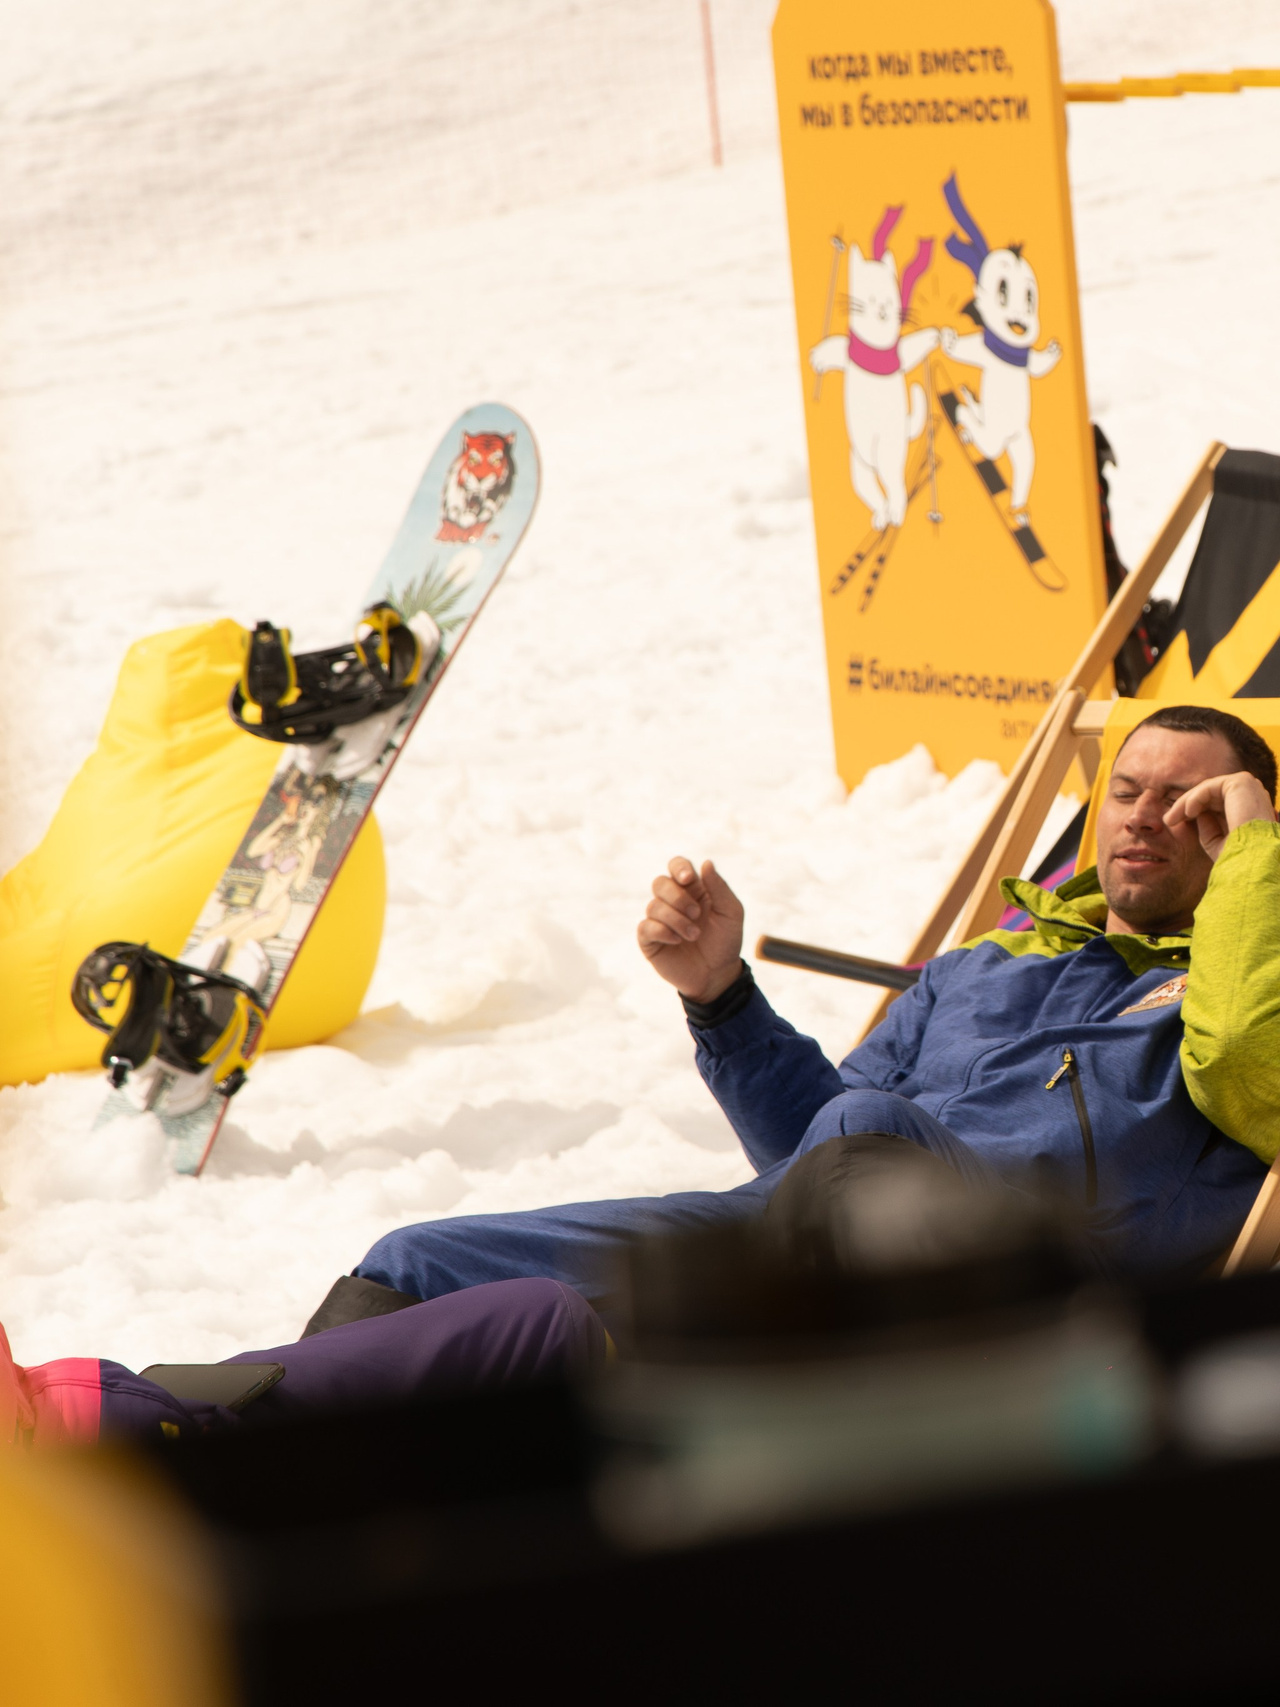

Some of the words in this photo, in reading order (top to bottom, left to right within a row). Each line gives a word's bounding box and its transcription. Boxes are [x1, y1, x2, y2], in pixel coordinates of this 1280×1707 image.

[808, 53, 871, 80] когда
[878, 52, 912, 76] мы
[919, 47, 1013, 76] вместе,
[800, 103, 835, 127] мы
[842, 102, 853, 126] в
[860, 93, 1030, 126] безопасности
[848, 655, 1058, 705] #билайнсоединя
